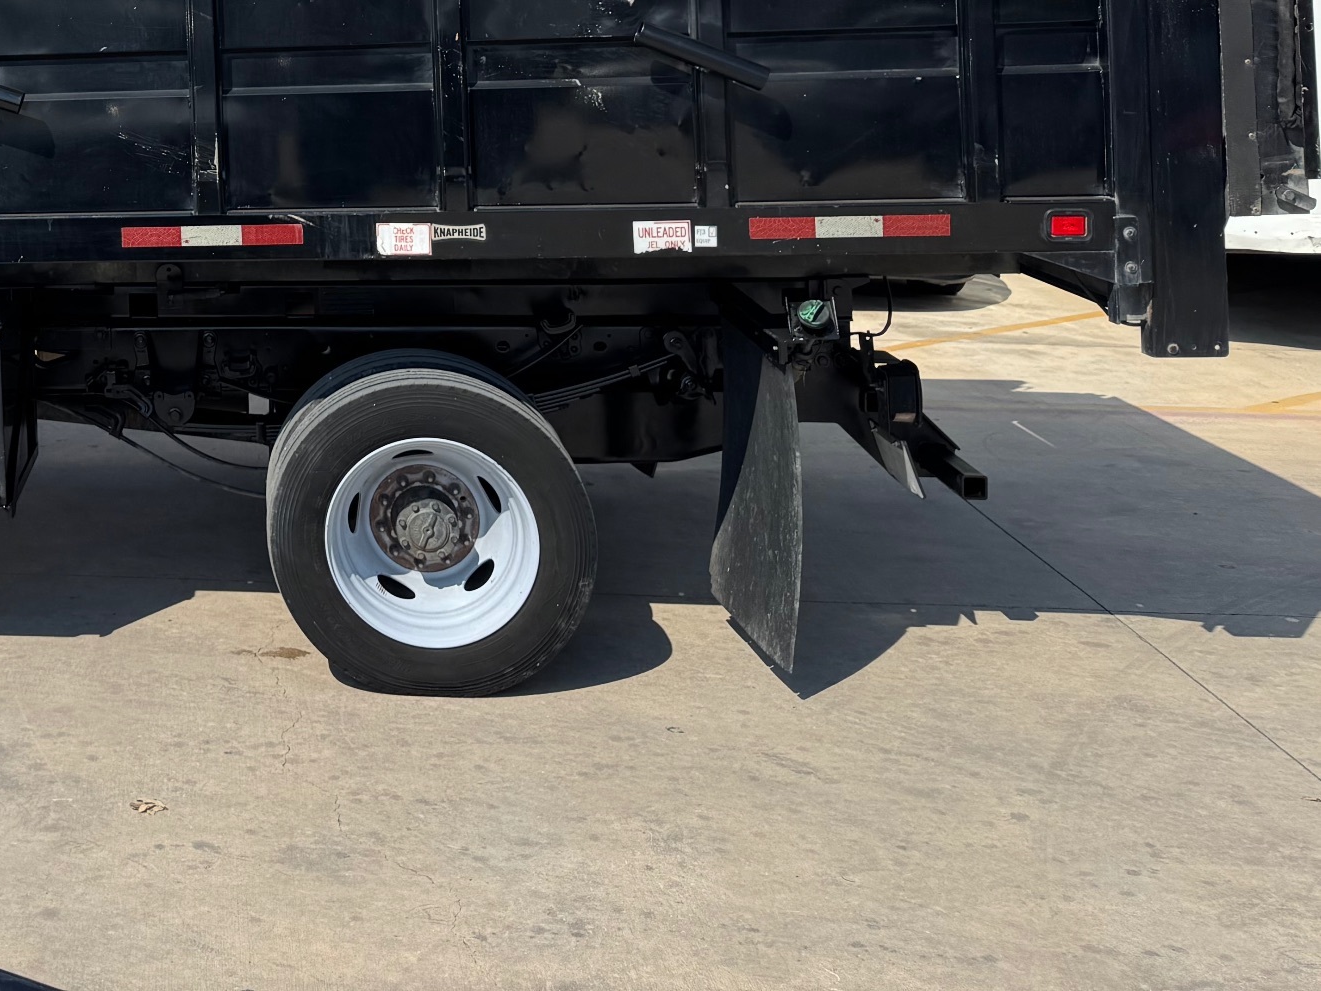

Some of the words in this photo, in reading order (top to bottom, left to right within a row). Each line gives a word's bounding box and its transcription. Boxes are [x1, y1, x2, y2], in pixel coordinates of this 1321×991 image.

[392, 227, 415, 235] CHECK
[433, 226, 485, 239] KNAPHEIDE
[637, 226, 687, 239] UNLEADED
[394, 235, 414, 244] TIRES
[393, 244, 414, 252] DAILY
